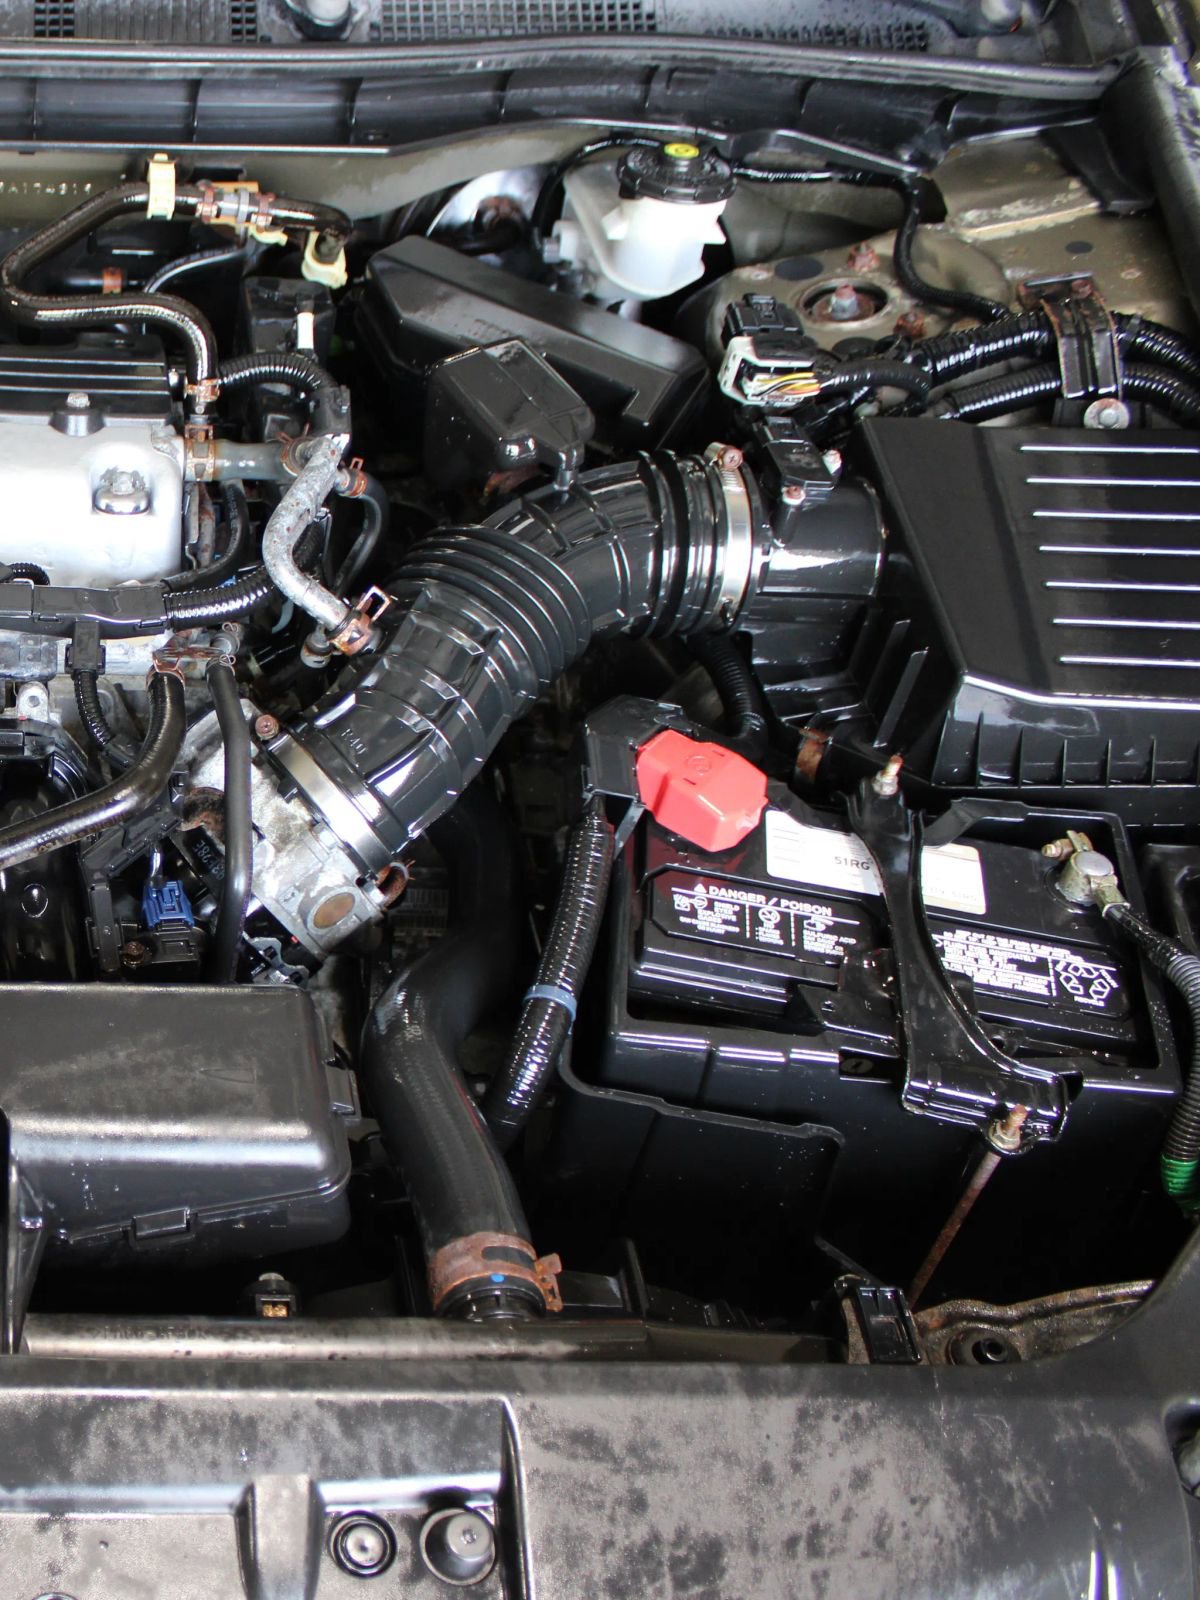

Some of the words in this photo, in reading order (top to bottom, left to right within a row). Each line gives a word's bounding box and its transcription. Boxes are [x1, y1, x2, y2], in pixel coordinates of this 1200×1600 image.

[708, 886, 766, 905] DANGER
[780, 899, 833, 917] POISON
[838, 936, 857, 945] ACID
